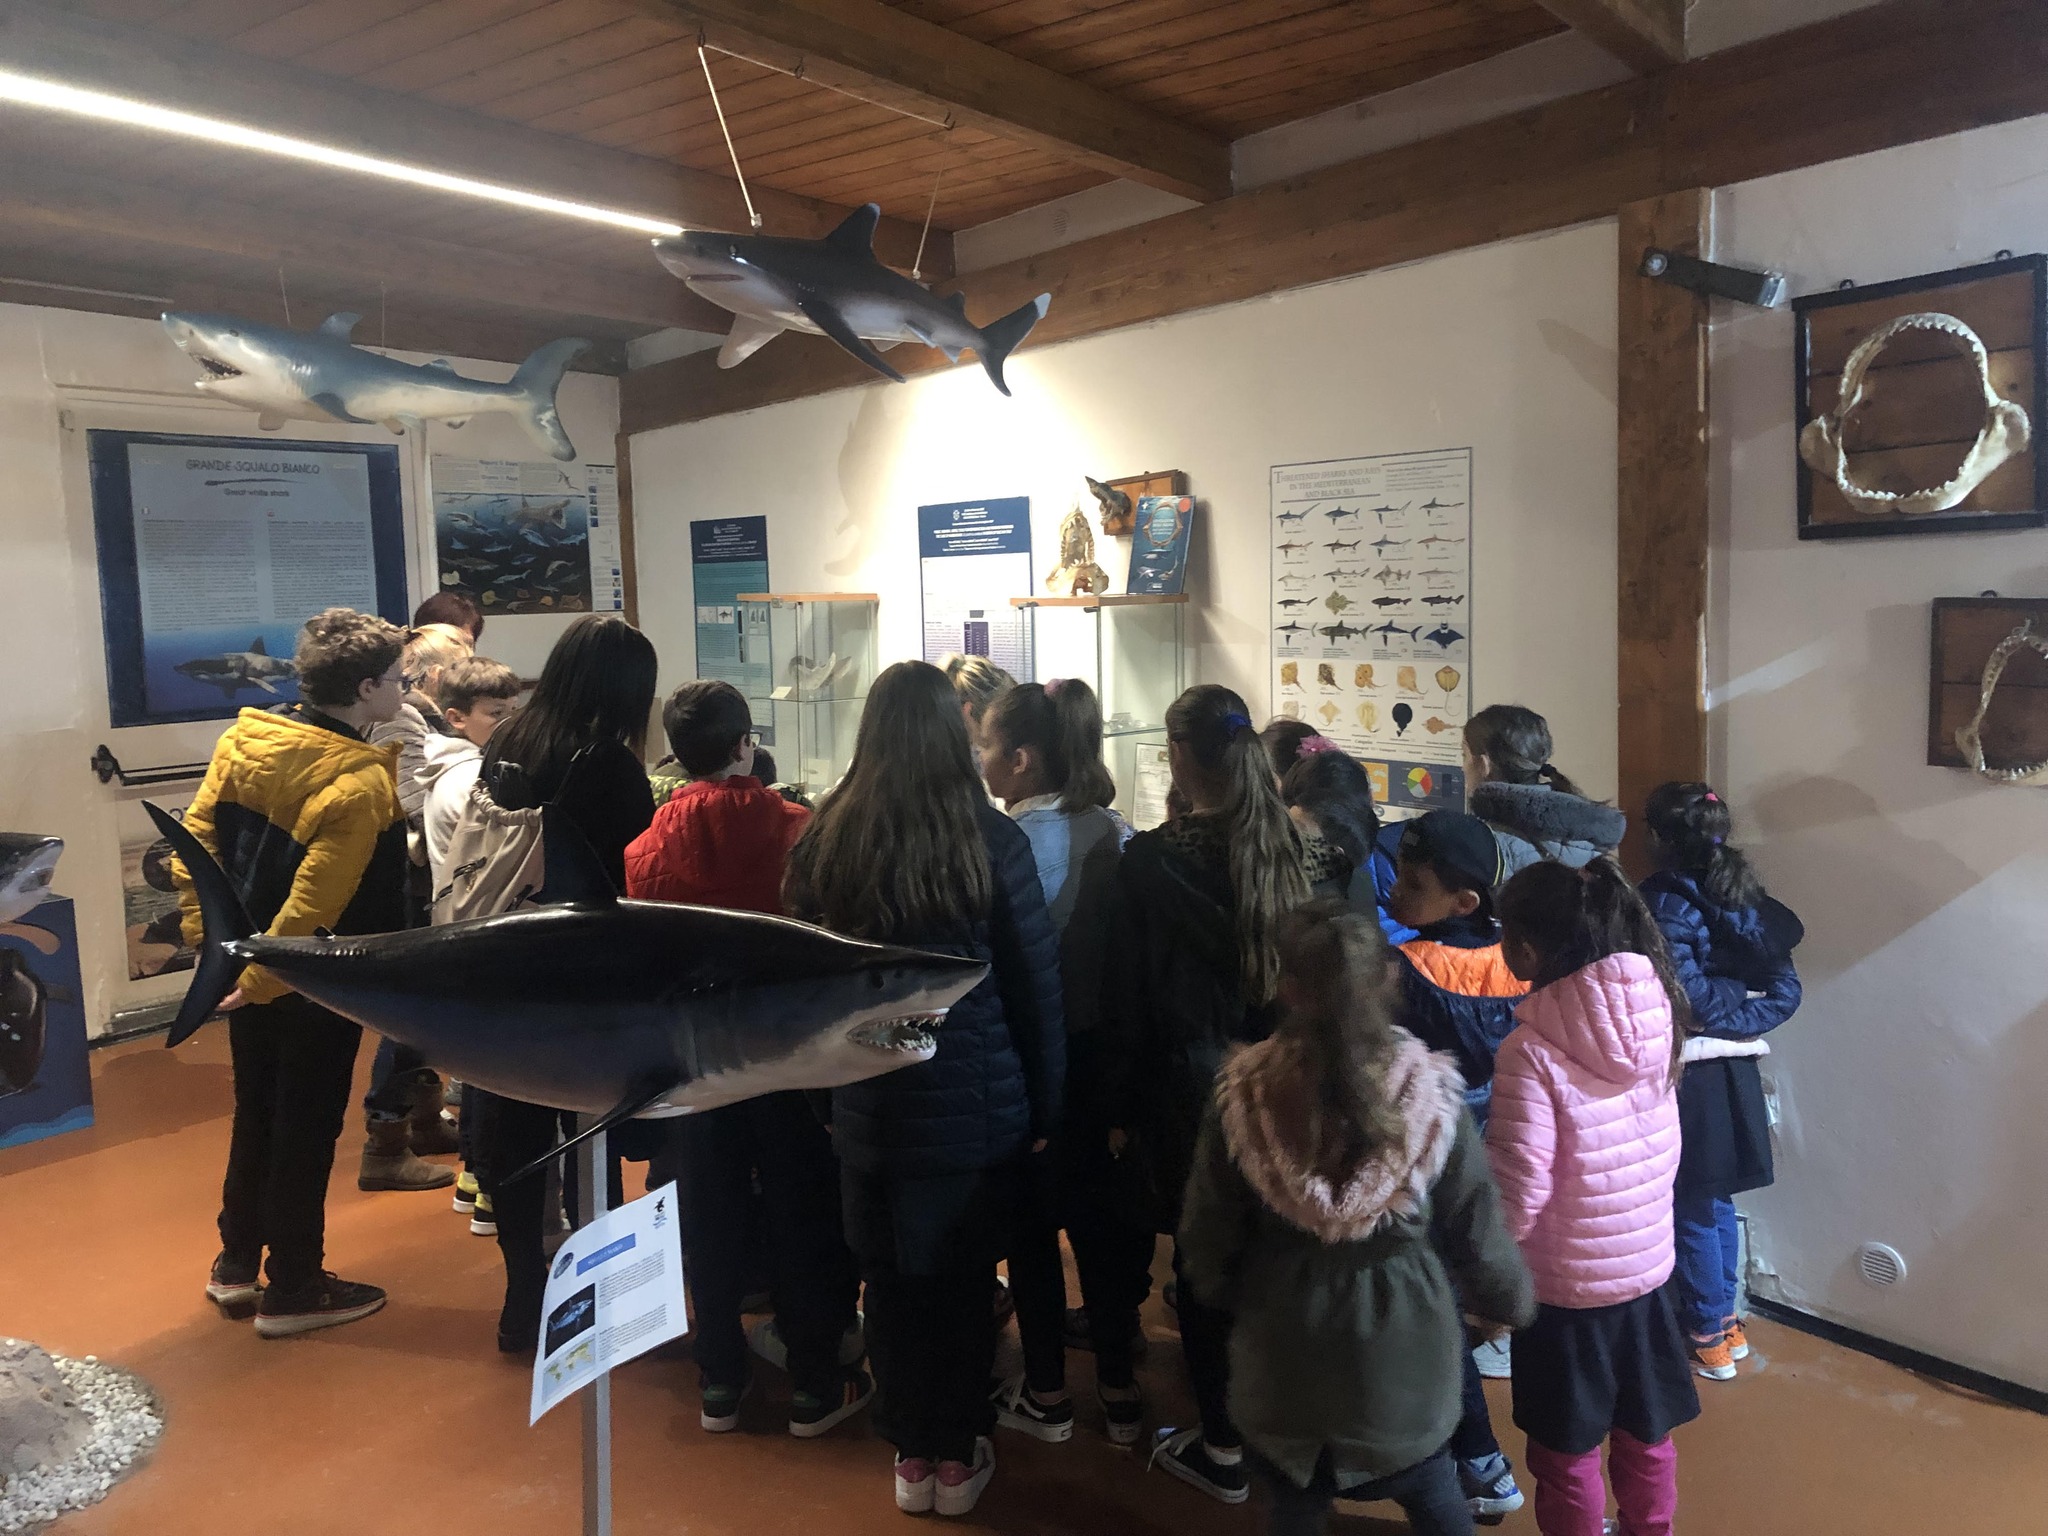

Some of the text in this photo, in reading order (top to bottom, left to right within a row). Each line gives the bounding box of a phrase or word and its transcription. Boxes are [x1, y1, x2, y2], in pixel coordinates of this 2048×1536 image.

[186, 459, 231, 471] GRANDE
[235, 460, 279, 473] SQUALO
[282, 462, 320, 474] BIANCO
